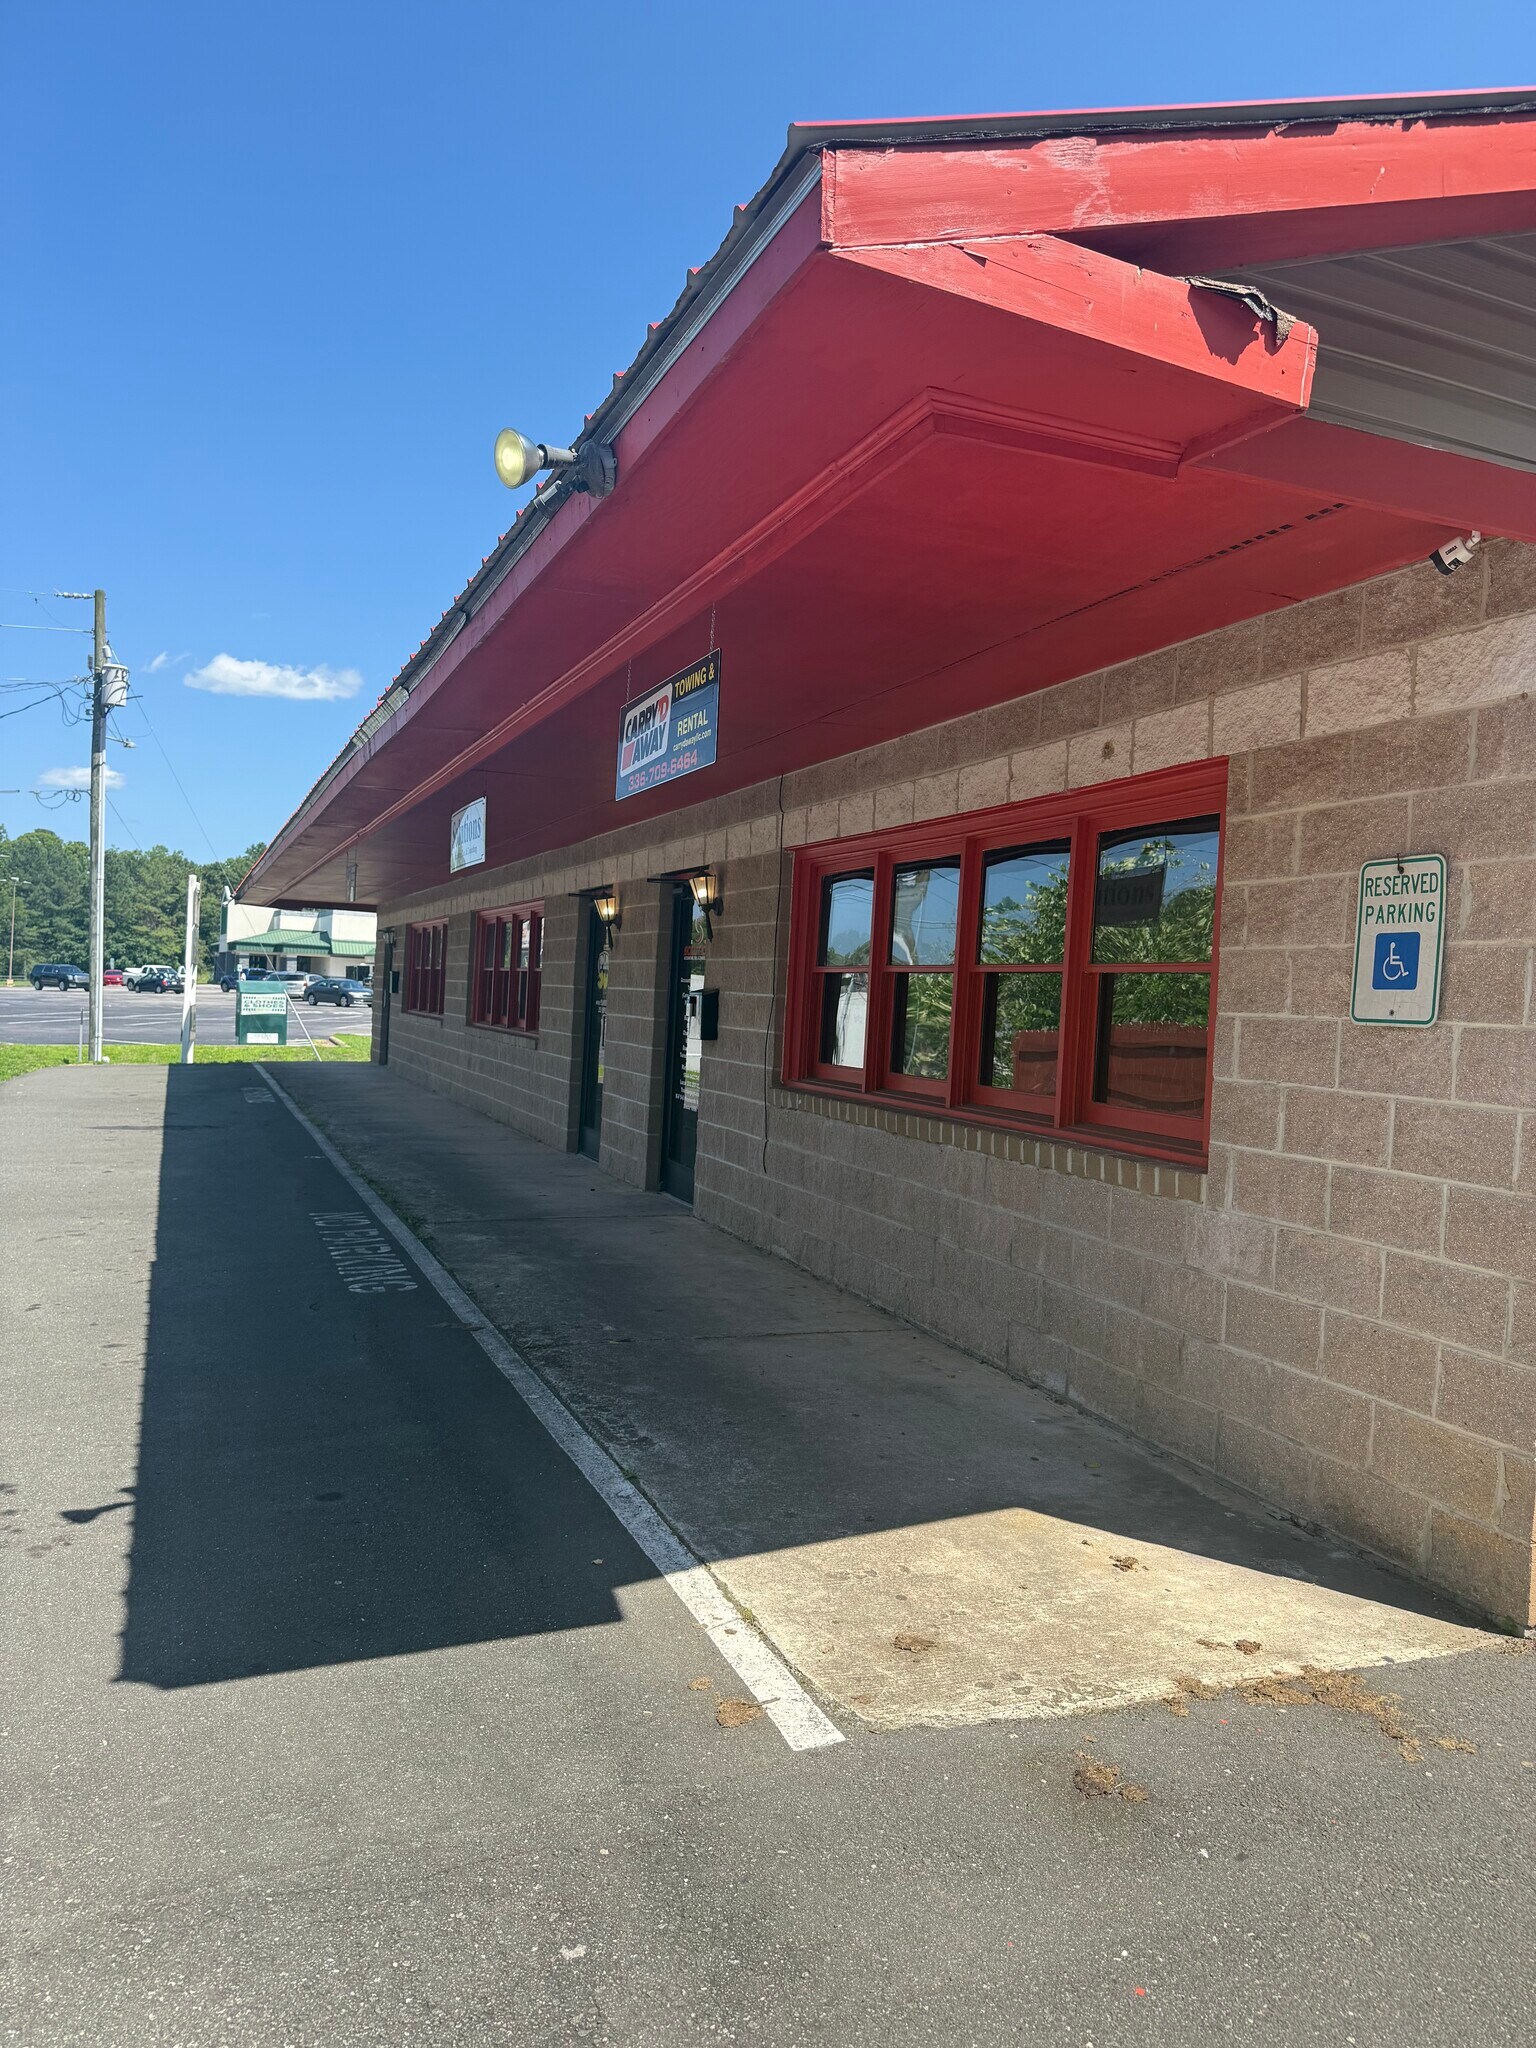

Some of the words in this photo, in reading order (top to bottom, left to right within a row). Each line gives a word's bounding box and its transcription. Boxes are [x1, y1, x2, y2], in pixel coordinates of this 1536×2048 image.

[675, 666, 707, 698] TOWING
[708, 663, 715, 680] &
[625, 694, 669, 743] CARRY'D
[677, 709, 708, 737] RENTAL
[631, 722, 667, 766] AWAY
[1365, 872, 1439, 897] RESERVED
[1365, 901, 1436, 925] PARKING
[308, 1211, 371, 1227] NO
[319, 1228, 418, 1294] PARKING
